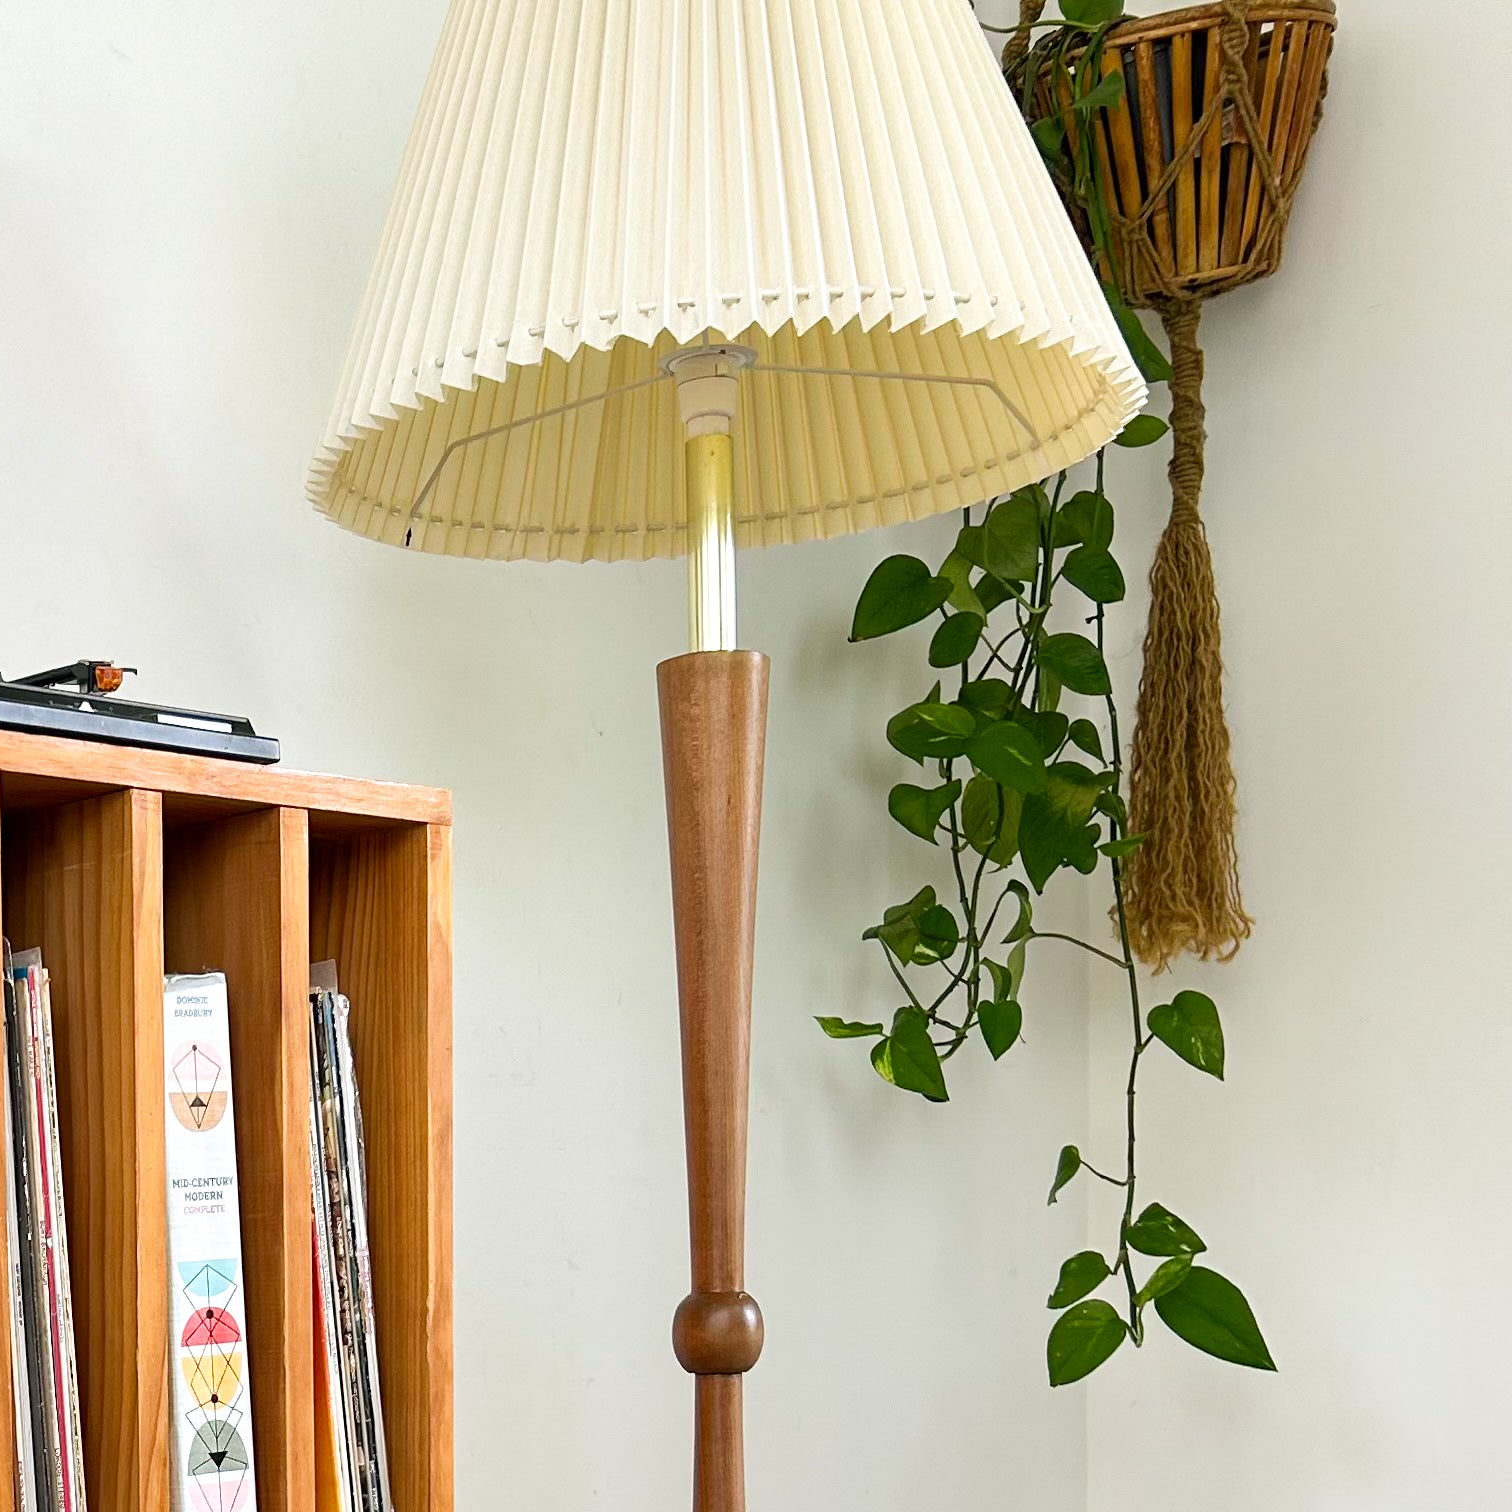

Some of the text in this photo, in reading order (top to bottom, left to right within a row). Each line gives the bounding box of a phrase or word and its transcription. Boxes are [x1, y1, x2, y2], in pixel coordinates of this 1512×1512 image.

[177, 995, 209, 1005] DOMINIC
[174, 1008, 213, 1018] BRADBURY
[172, 1177, 234, 1190] MID-CENTURY
[184, 1190, 224, 1202] MODERN
[184, 1204, 226, 1216] COMPLETE
